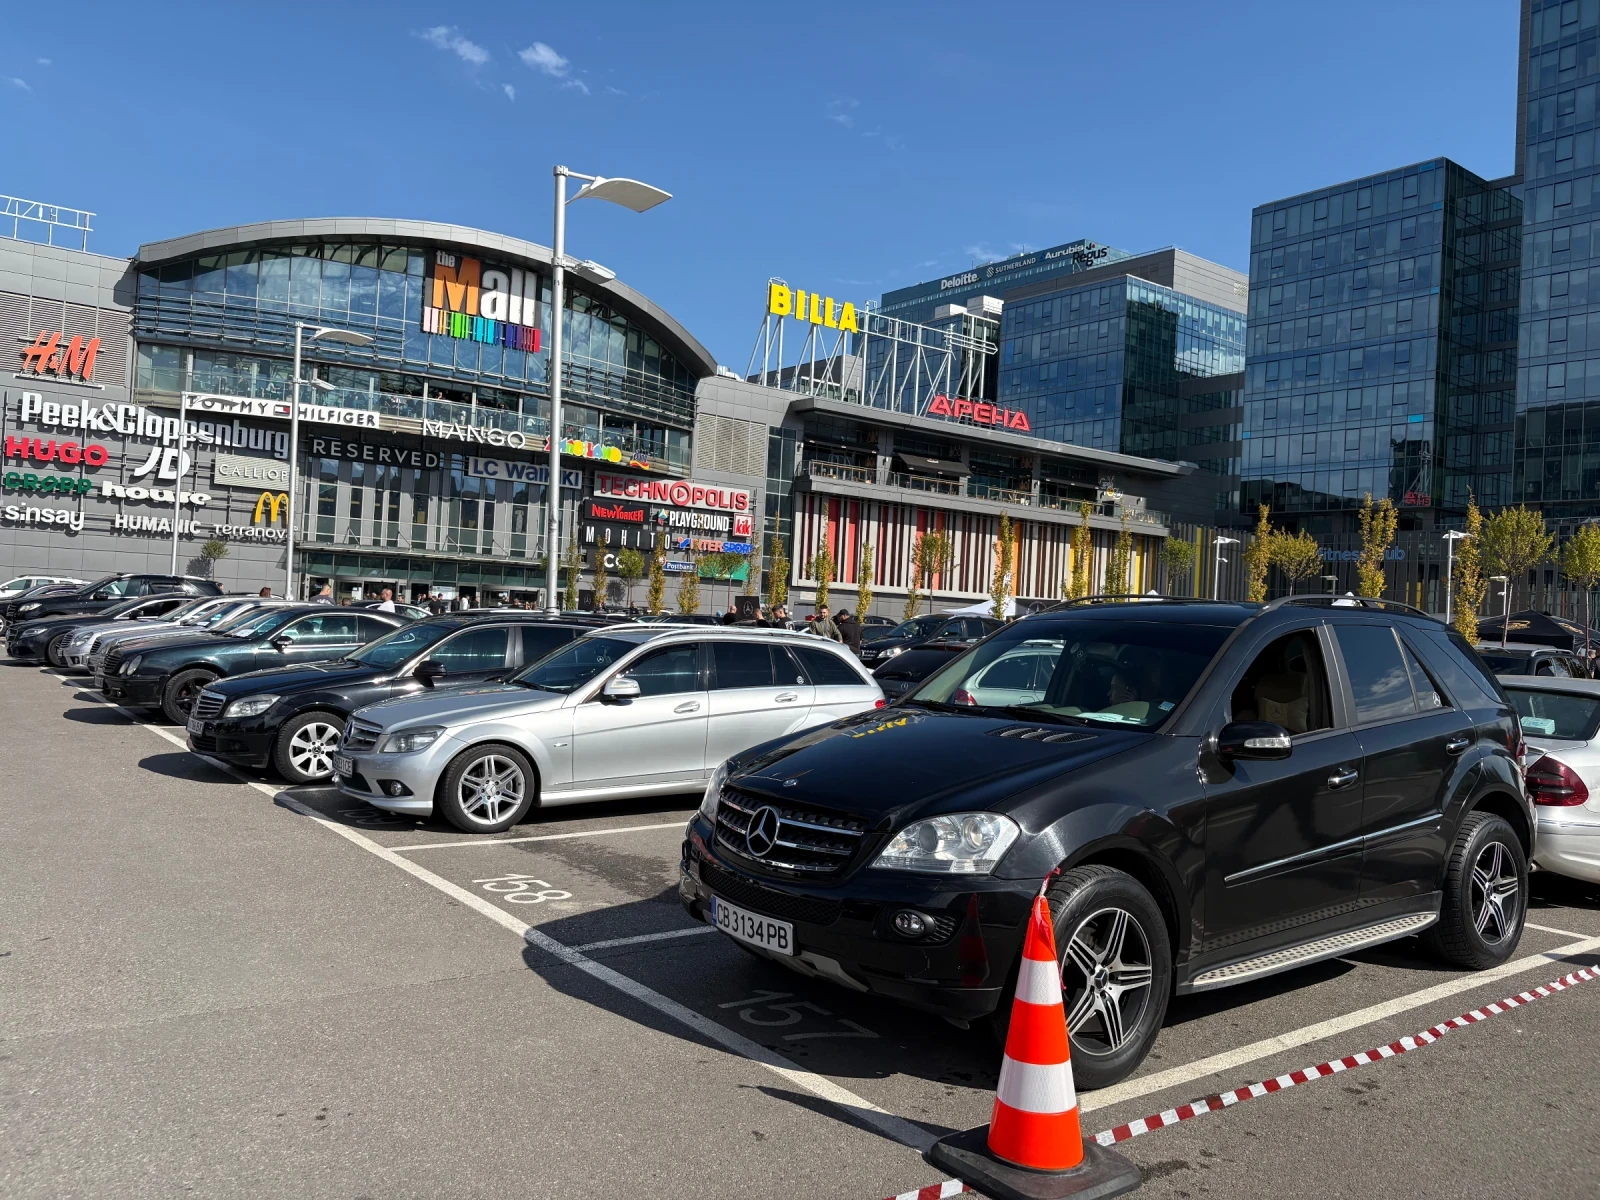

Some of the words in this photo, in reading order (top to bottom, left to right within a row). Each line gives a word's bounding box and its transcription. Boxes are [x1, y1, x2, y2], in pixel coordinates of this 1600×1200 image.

[436, 250, 455, 268] the
[1045, 244, 1084, 259] Aurubis
[1072, 247, 1108, 267] Regus
[995, 257, 1036, 274] SUTHERLAND
[432, 256, 538, 328] Mall
[769, 283, 858, 334] BILLA
[23, 330, 101, 380] H&M
[298, 406, 375, 427] HILFIGER
[423, 418, 526, 449] MANGO
[5, 436, 109, 466] HUGO
[312, 438, 438, 468] RESERVED
[134, 446, 191, 480] JD
[219, 463, 290, 482] CALLIOP
[473, 458, 499, 476] LC
[5, 471, 93, 494] CROPP
[5, 502, 84, 531] sinsay
[669, 510, 730, 532] PLAYGROUND
[213, 523, 289, 539] terranov
[585, 526, 671, 550] MOHITO
[666, 562, 694, 571] Postbank
[472, 873, 573, 904] 158
[718, 990, 881, 1041] 157
